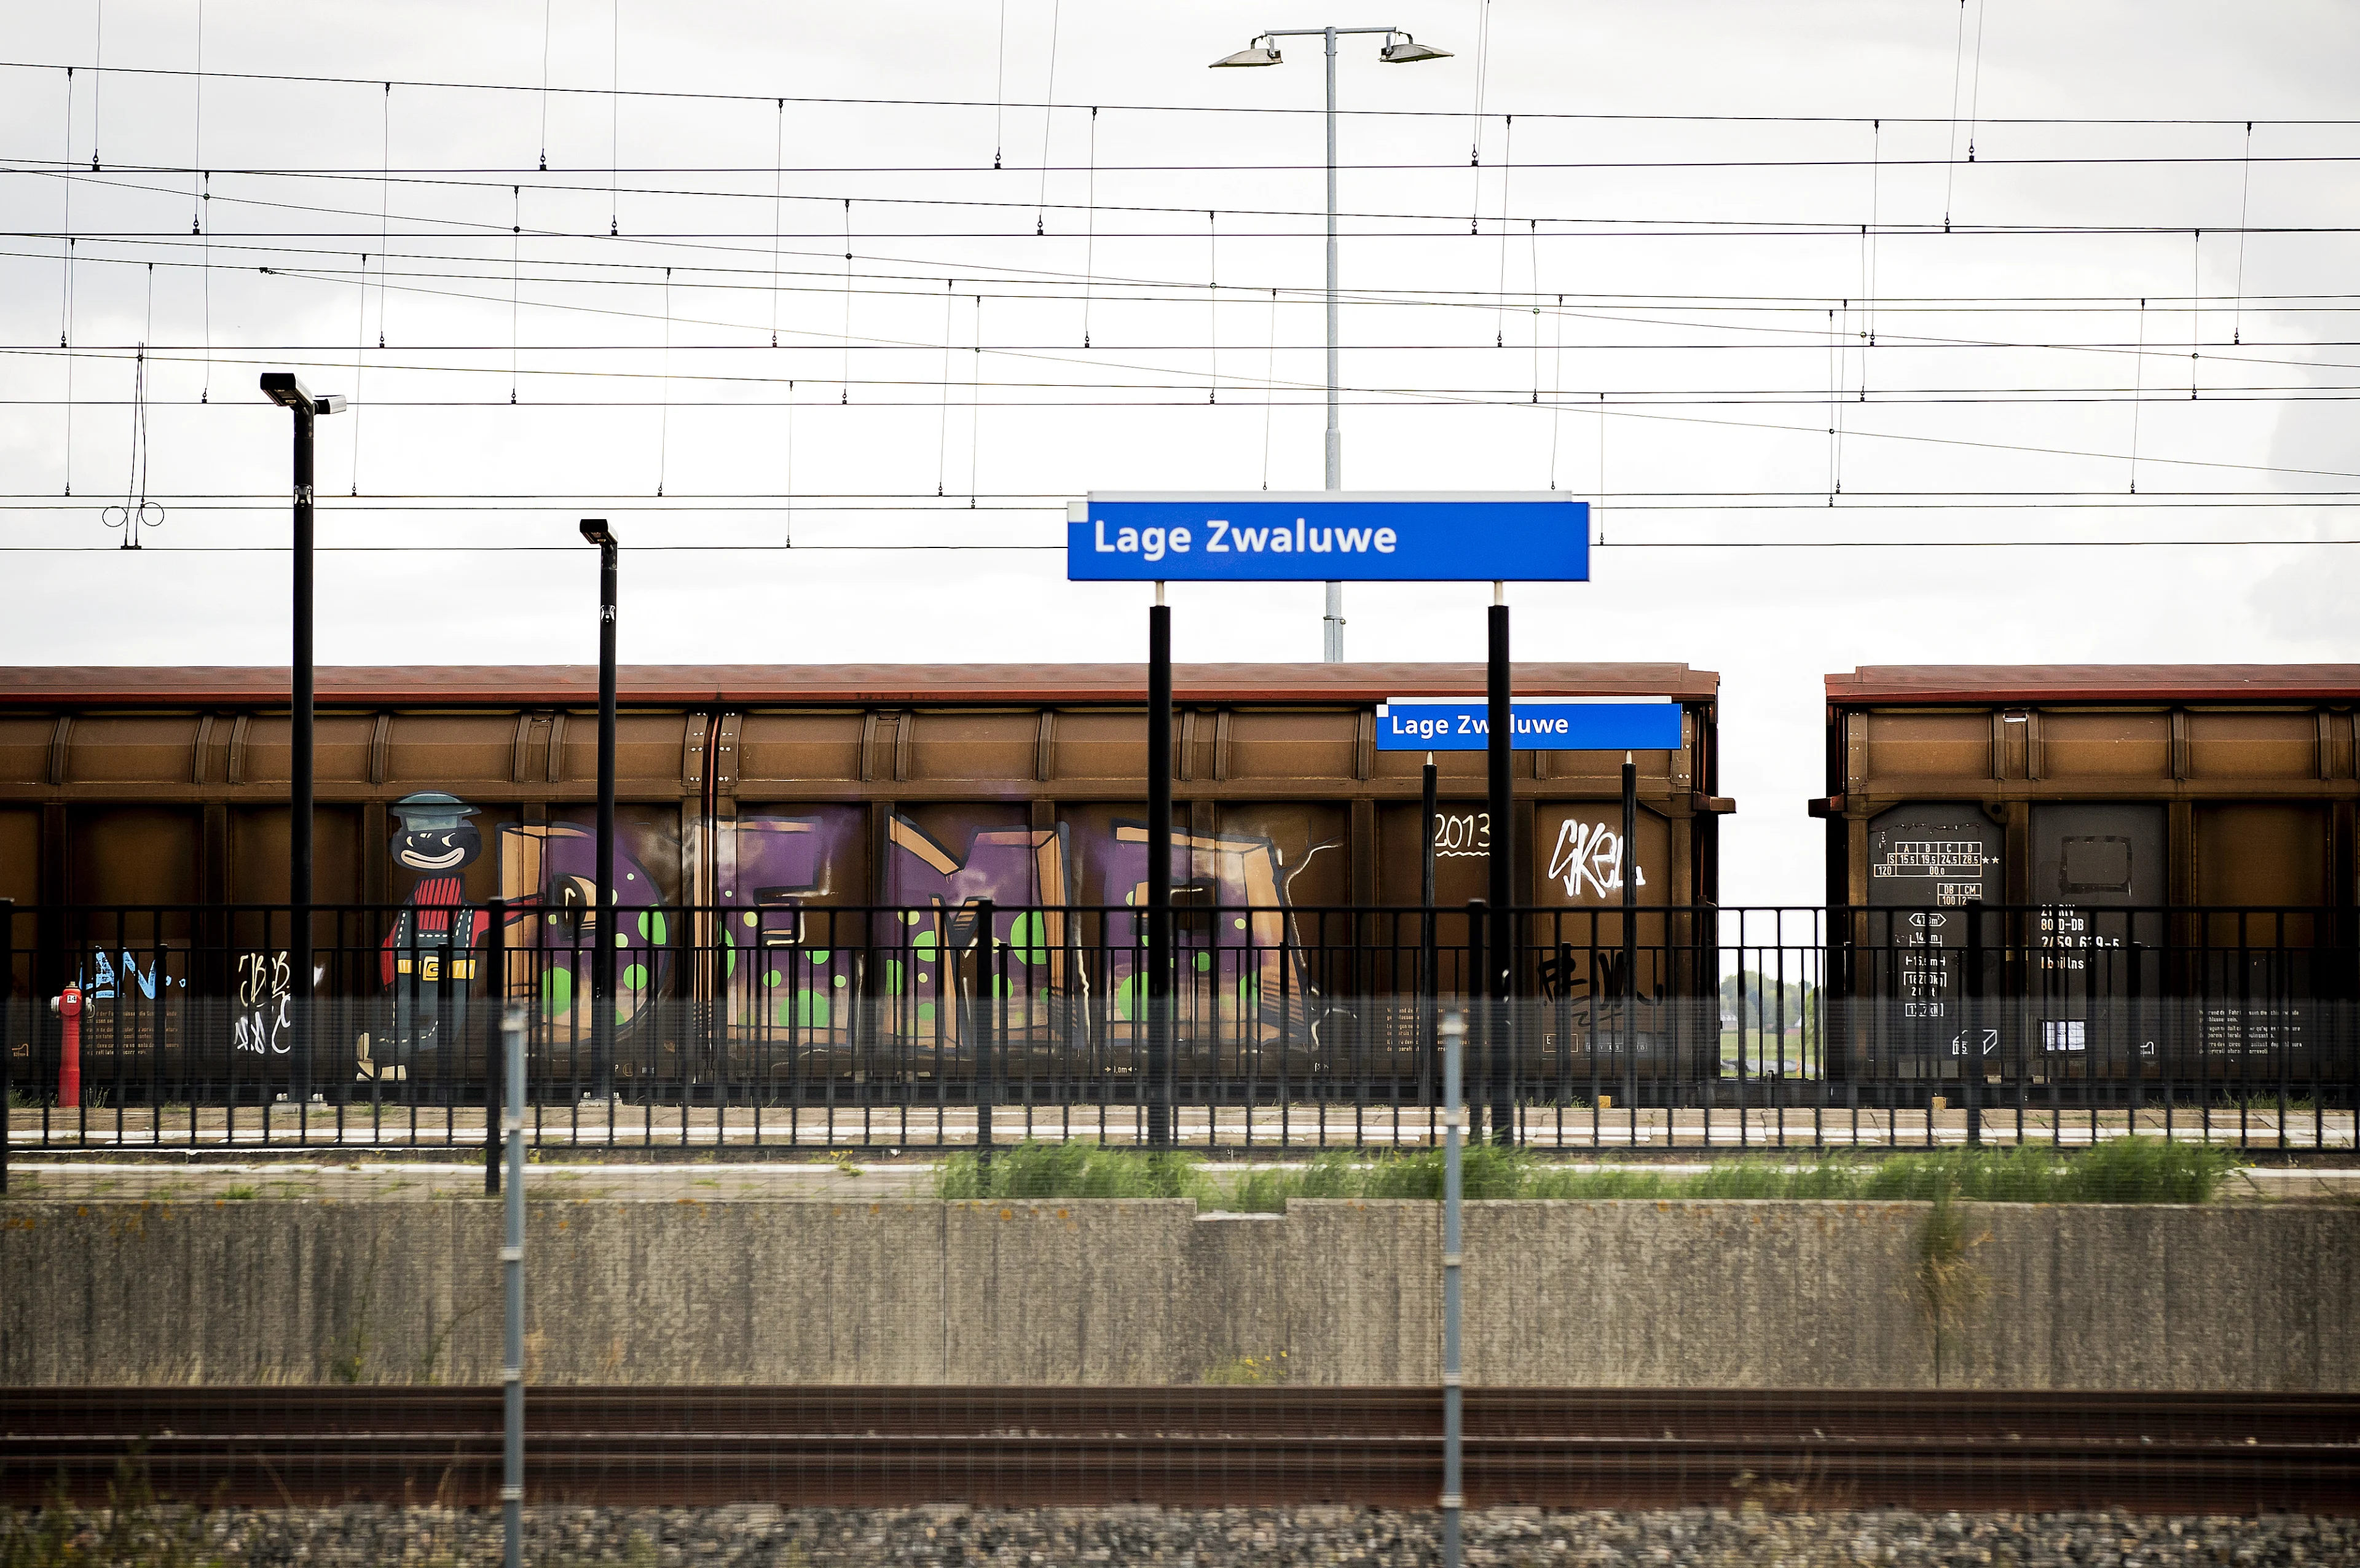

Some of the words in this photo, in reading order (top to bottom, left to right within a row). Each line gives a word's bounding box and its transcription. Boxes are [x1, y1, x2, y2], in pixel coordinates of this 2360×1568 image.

[1095, 519, 1191, 562] Lage
[1206, 518, 1397, 554] Zwaluwe
[1392, 715, 1448, 739] Lage
[1457, 715, 1568, 735] Zwluwe
[1434, 813, 1490, 849] 2013
[1903, 844, 1910, 853] A
[1925, 844, 1930, 853] B
[1946, 844, 1952, 853] C
[1968, 844, 1973, 853] D
[1900, 855, 1914, 864] 15.5
[1921, 855, 1936, 864] 19.5
[1941, 855, 1957, 864] 24.5
[1962, 855, 1978, 864] 28.5
[1878, 866, 1892, 876] 120
[1944, 885, 1954, 895] DB
[1964, 885, 1976, 895] CM
[1942, 896, 1956, 905] 100
[2041, 918, 2054, 931] 80
[2058, 918, 2084, 932] D-DB
